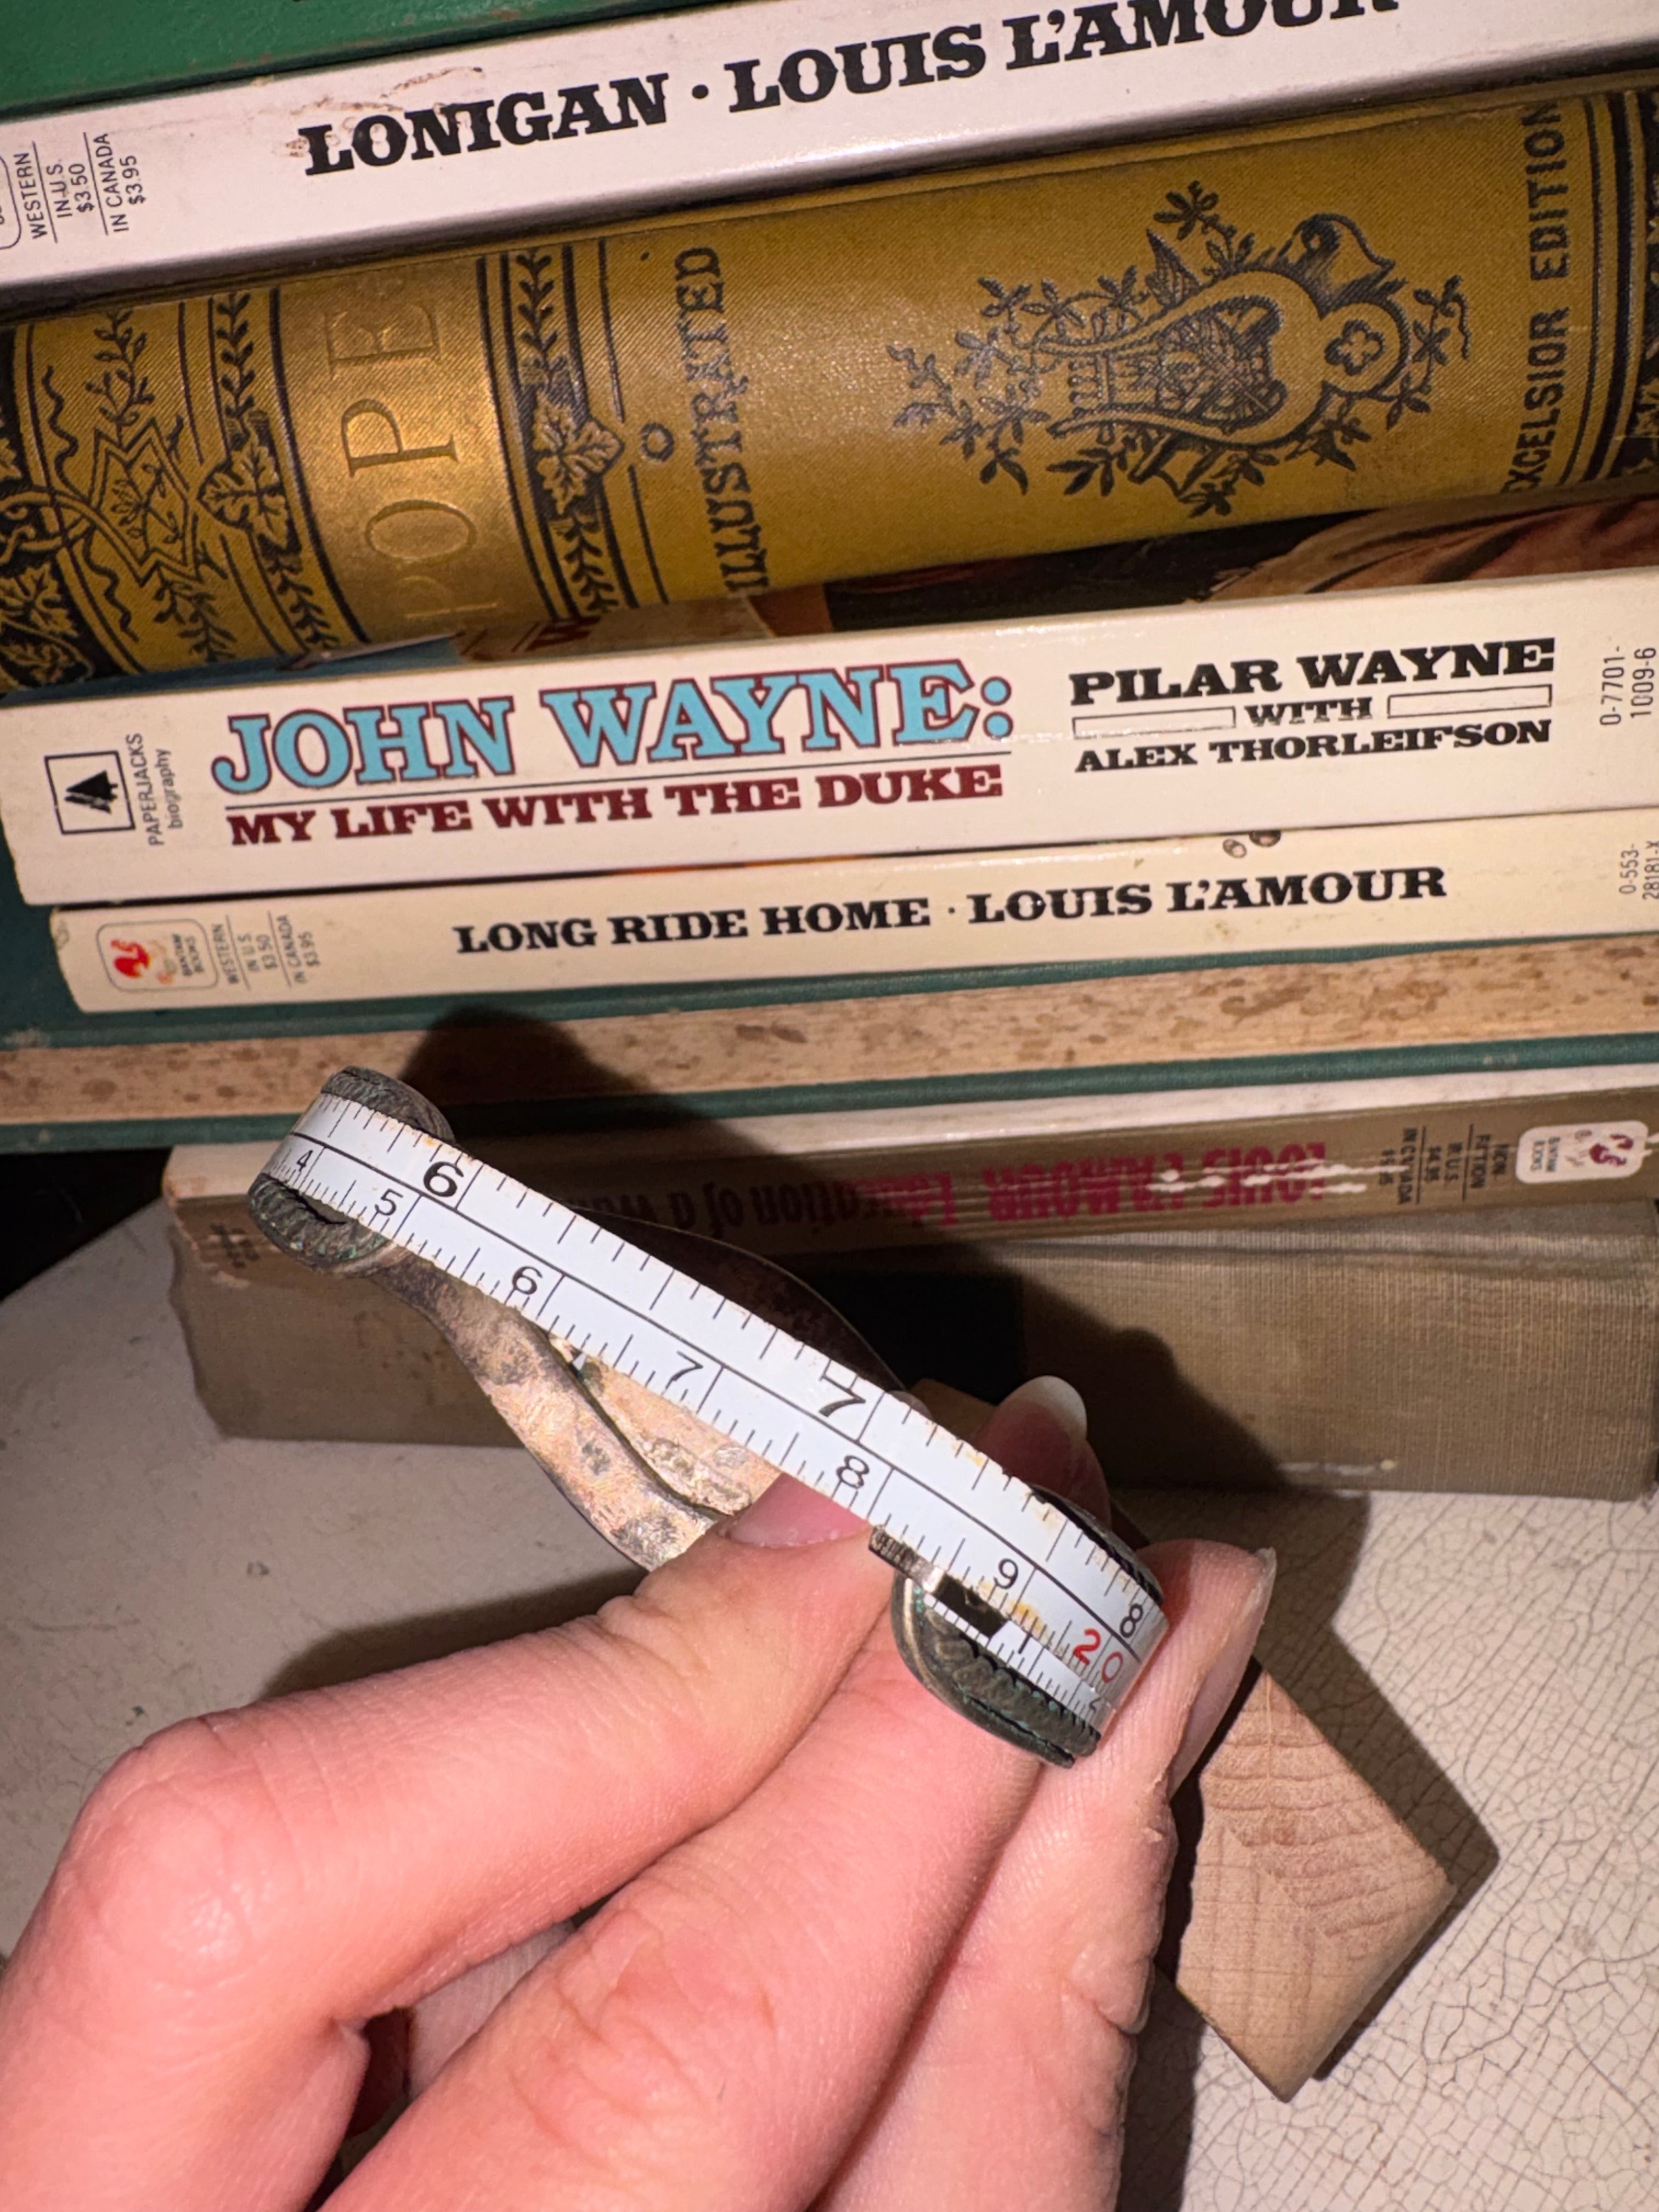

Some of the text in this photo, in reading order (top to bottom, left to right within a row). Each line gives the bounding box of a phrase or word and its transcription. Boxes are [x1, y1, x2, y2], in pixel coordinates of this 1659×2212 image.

[297, 72, 669, 176] LONIGAN
[724, 23, 986, 112] LOUIS
[13, 153, 48, 239] WESTERN
[53, 199, 73, 218] IN
[93, 133, 129, 232] IN CANADA
[119, 155, 146, 205] $3.95
[1499, 306, 1570, 494] XCELSIOR
[1069, 637, 1556, 706] PILAR WAYNE
[1245, 697, 1374, 727] WITH
[1630, 647, 1657, 719] 1009-6
[211, 658, 1014, 795] JOHN WAYNE:
[1075, 719, 1552, 773] ALEX THORLEIFSON
[126, 732, 165, 847] PAPERJACKS
[154, 748, 184, 830] biography
[227, 764, 1003, 845] MY LIFE WITH THE DUKE
[451, 866, 1447, 953] LONG RIDE HOME LOUIS L'AMOUR
[212, 923, 239, 984] WESTERN
[295, 1150, 313, 1172] 4
[374, 1188, 404, 1216] 5
[511, 1265, 543, 1296] 6
[670, 1351, 703, 1383] 7
[836, 1454, 870, 1489] 8
[992, 1558, 1019, 1590] 9
[423, 1161, 1143, 1638] 6 7 8
